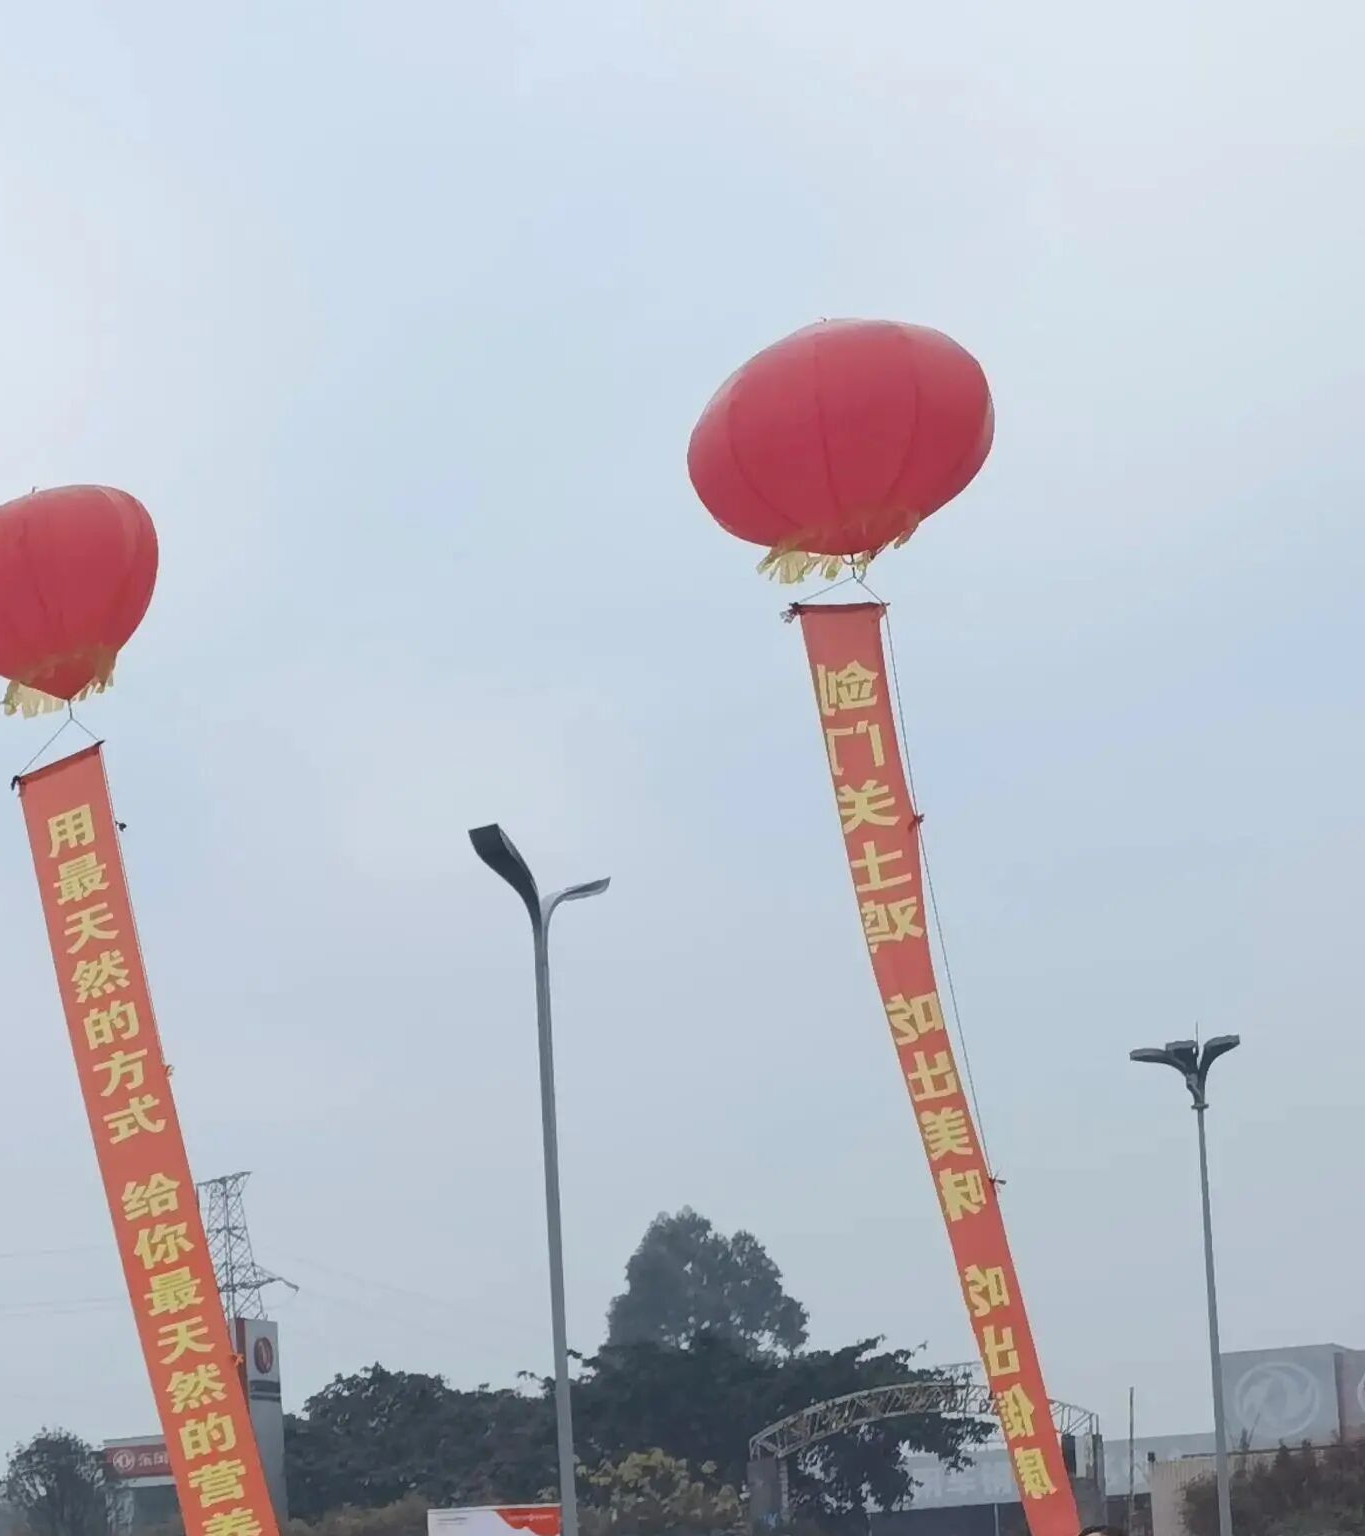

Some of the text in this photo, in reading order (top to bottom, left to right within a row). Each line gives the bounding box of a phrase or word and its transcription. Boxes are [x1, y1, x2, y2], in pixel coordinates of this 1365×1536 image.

[47, 803, 168, 1145] 用最天然的方式
